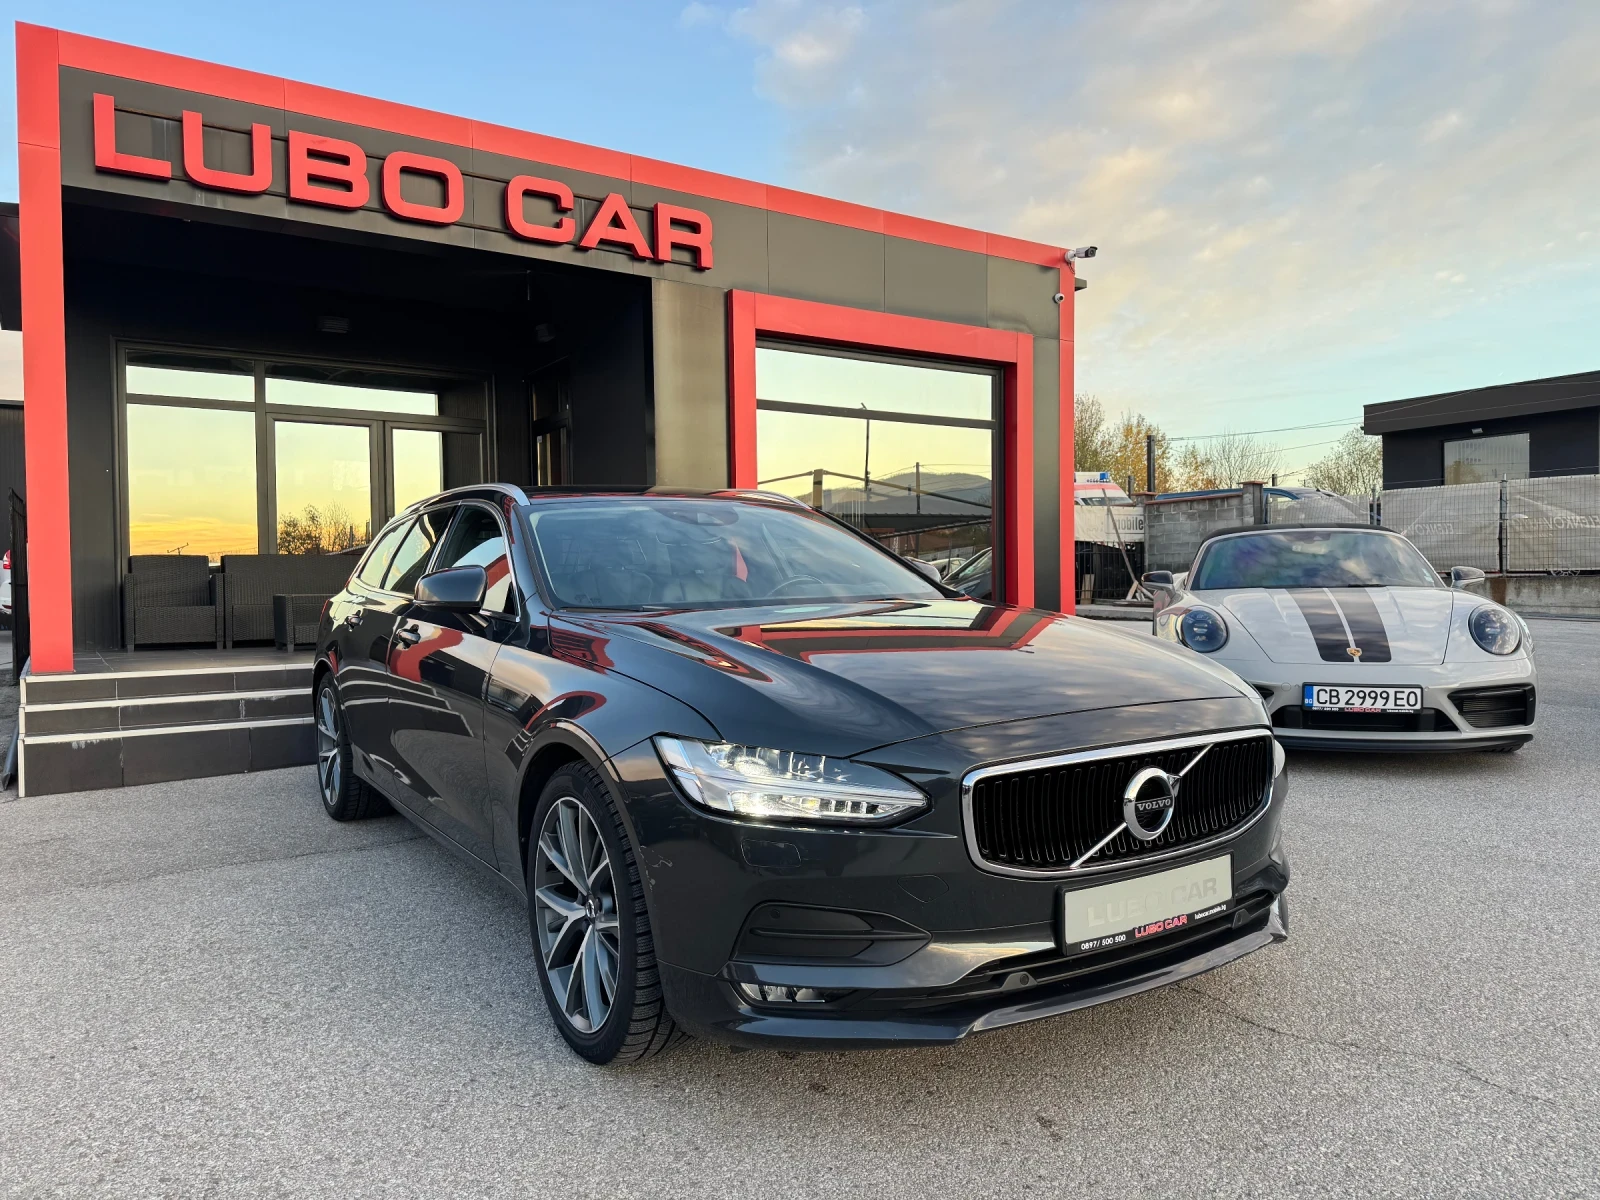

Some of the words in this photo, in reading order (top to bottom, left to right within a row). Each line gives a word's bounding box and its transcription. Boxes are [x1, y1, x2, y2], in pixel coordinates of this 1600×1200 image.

[93, 92, 464, 225] LUBO
[504, 174, 713, 271] CAR
[1316, 688, 1340, 705] CB
[1344, 689, 1390, 706] 2999
[1136, 798, 1171, 811] VOLVO
[1087, 890, 1161, 928] LUBO
[1170, 877, 1217, 906] CAR
[1102, 937, 1114, 946] 500
[1115, 934, 1126, 943] 500
[1134, 922, 1164, 938] LUBO
[1164, 914, 1188, 930] CAR
